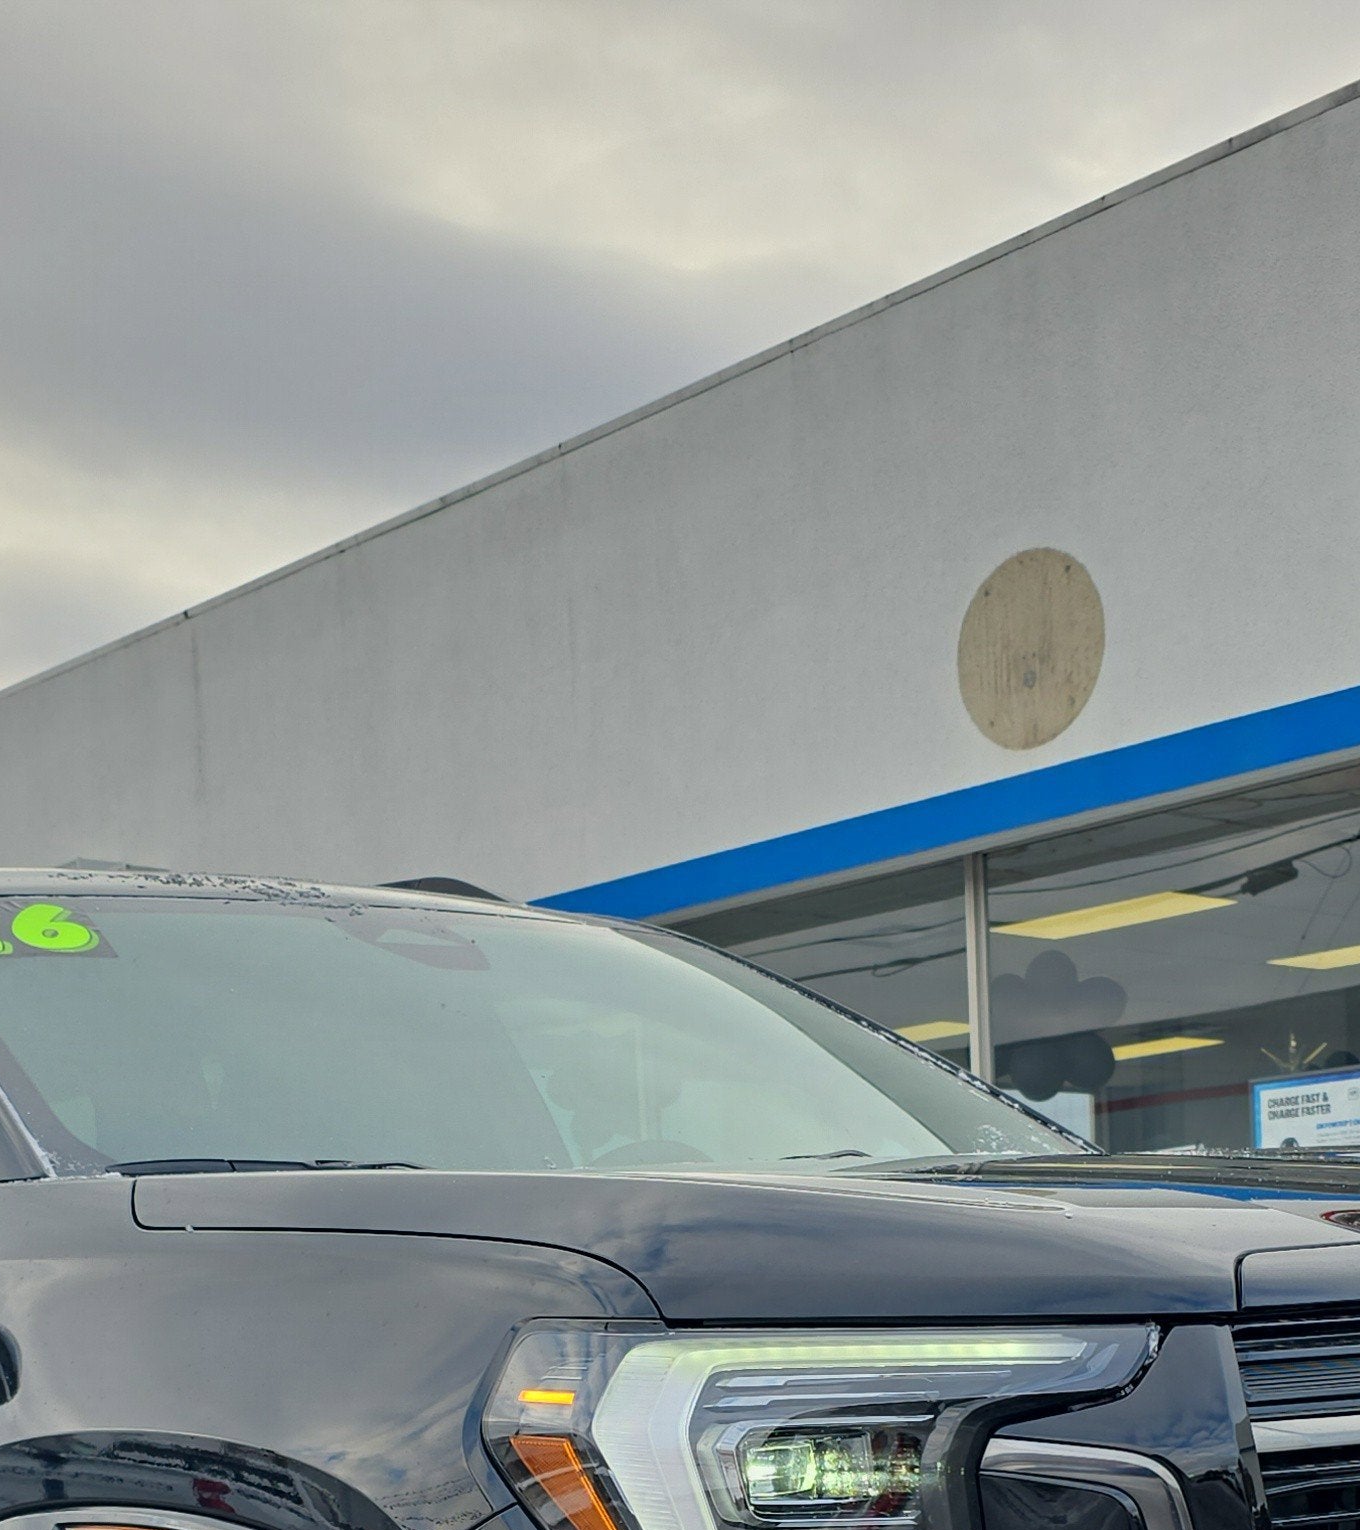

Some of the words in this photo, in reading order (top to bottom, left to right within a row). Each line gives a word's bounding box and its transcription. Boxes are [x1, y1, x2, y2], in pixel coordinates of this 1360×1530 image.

[1267, 1095, 1300, 1109] CHARGE
[1301, 1093, 1320, 1105] FAST
[1268, 1107, 1300, 1121] CHARGE
[1301, 1104, 1331, 1117] FASTER
